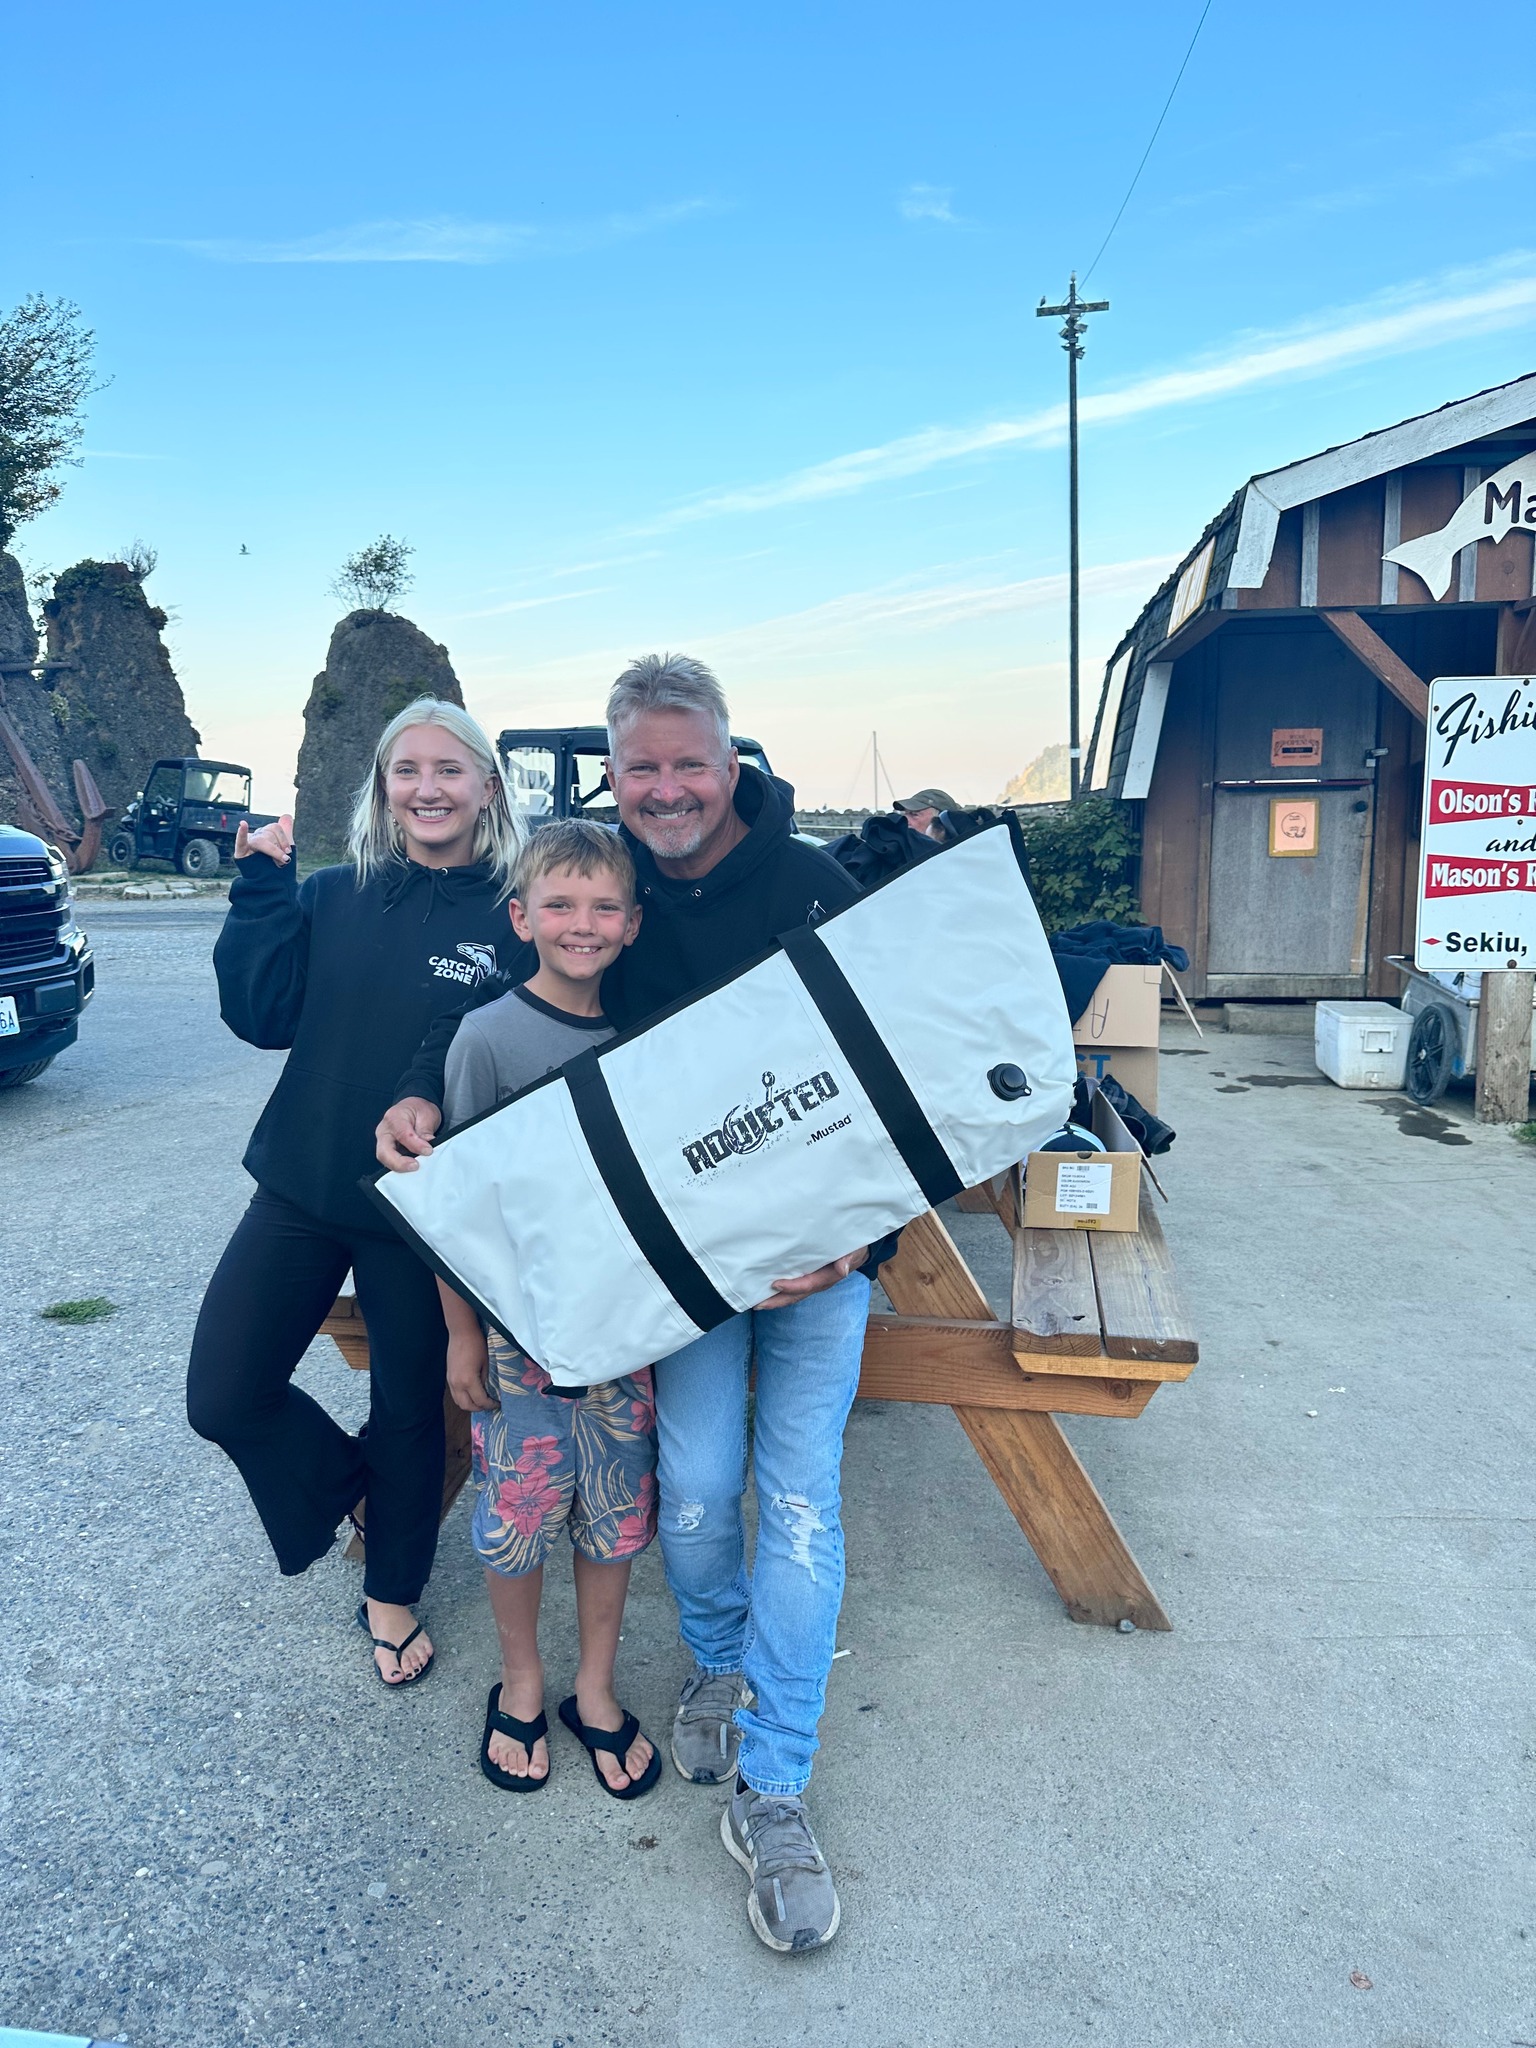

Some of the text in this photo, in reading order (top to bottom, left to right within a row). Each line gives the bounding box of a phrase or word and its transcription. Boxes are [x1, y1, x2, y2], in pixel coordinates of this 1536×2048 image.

[1436, 689, 1536, 768] Fishi
[1438, 788, 1521, 814] Olson's
[1486, 833, 1536, 852] and
[1430, 863, 1520, 887] Mason's
[1446, 932, 1527, 956] Sekiu,
[428, 956, 476, 976] CATCH
[433, 966, 473, 985] ZONE
[682, 1070, 840, 1175] ADDICTED
[811, 1114, 852, 1143] Mustad
